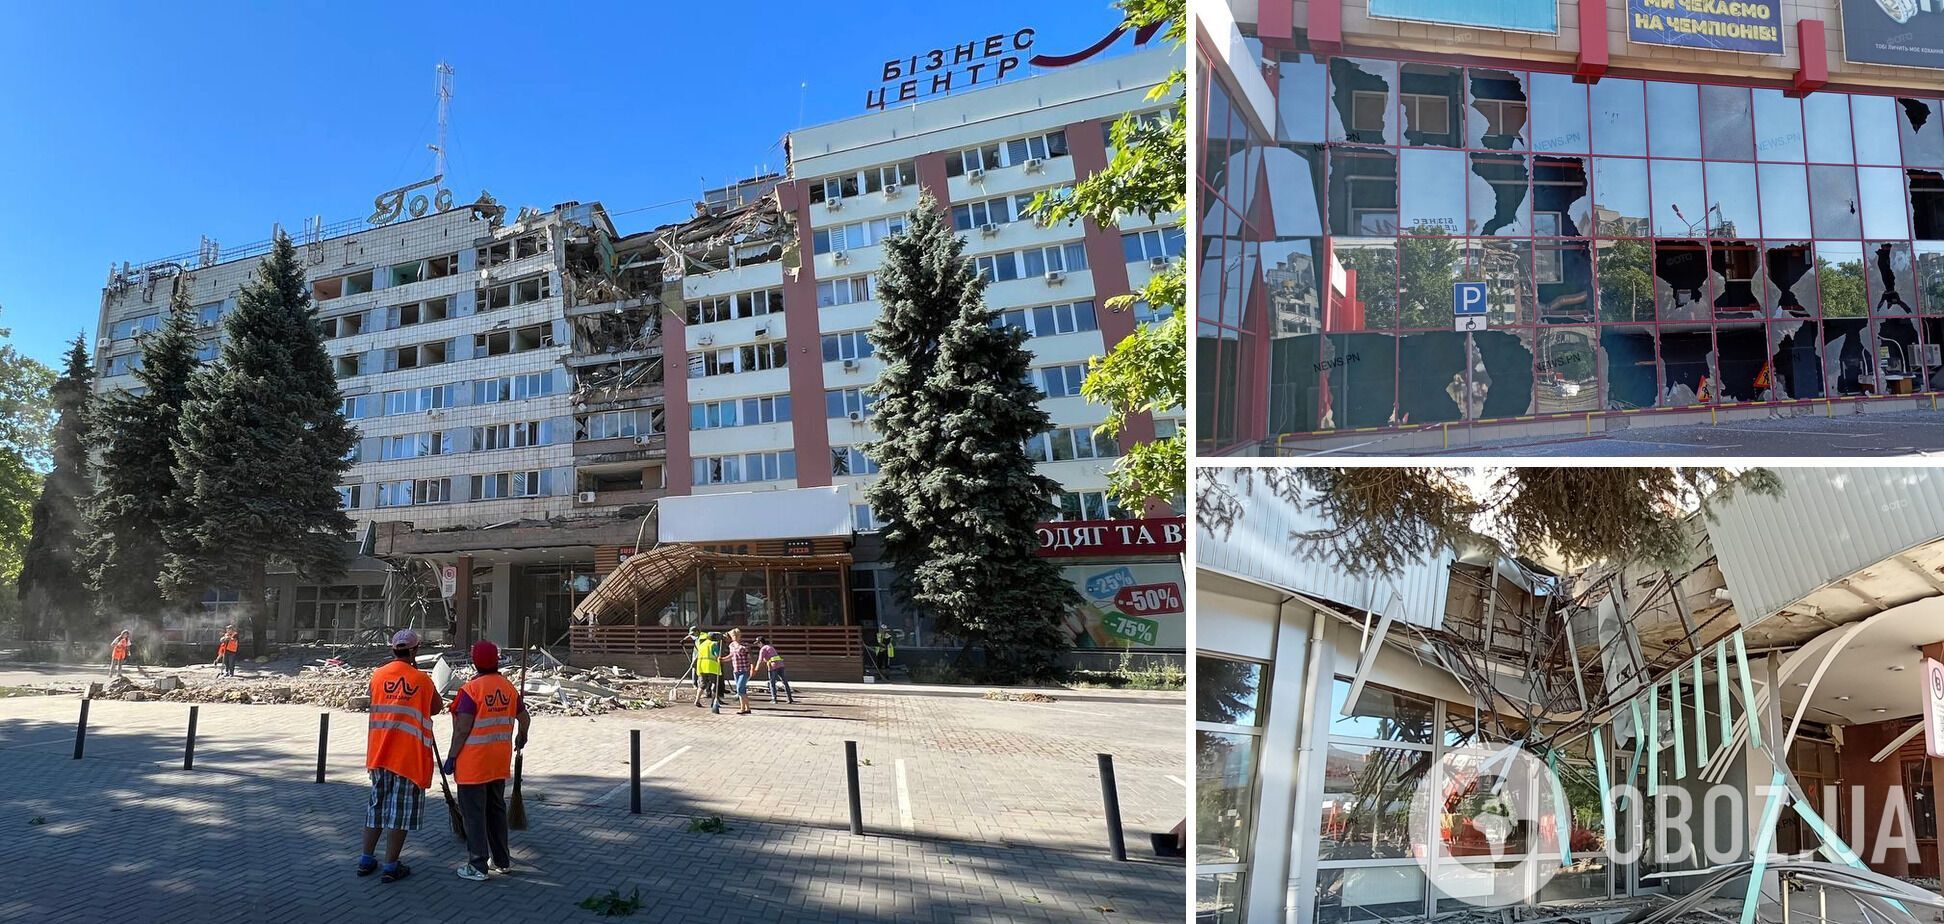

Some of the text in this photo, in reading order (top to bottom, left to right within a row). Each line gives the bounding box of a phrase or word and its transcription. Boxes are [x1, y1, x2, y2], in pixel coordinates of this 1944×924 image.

[1677, 0, 1771, 20] ЧЕКАЄМО
[1635, 13, 1778, 42] НА ЧЕМПІОНІВ!
[882, 28, 1036, 82] БІЗНЕС
[866, 57, 1019, 111] ЦЕНТР
[1463, 288, 1481, 311] P
[1035, 523, 1186, 550] ОДЯГ ТА В
[1094, 570, 1134, 594] -25%
[1126, 587, 1179, 611] -50%
[1109, 616, 1152, 642] -75%
